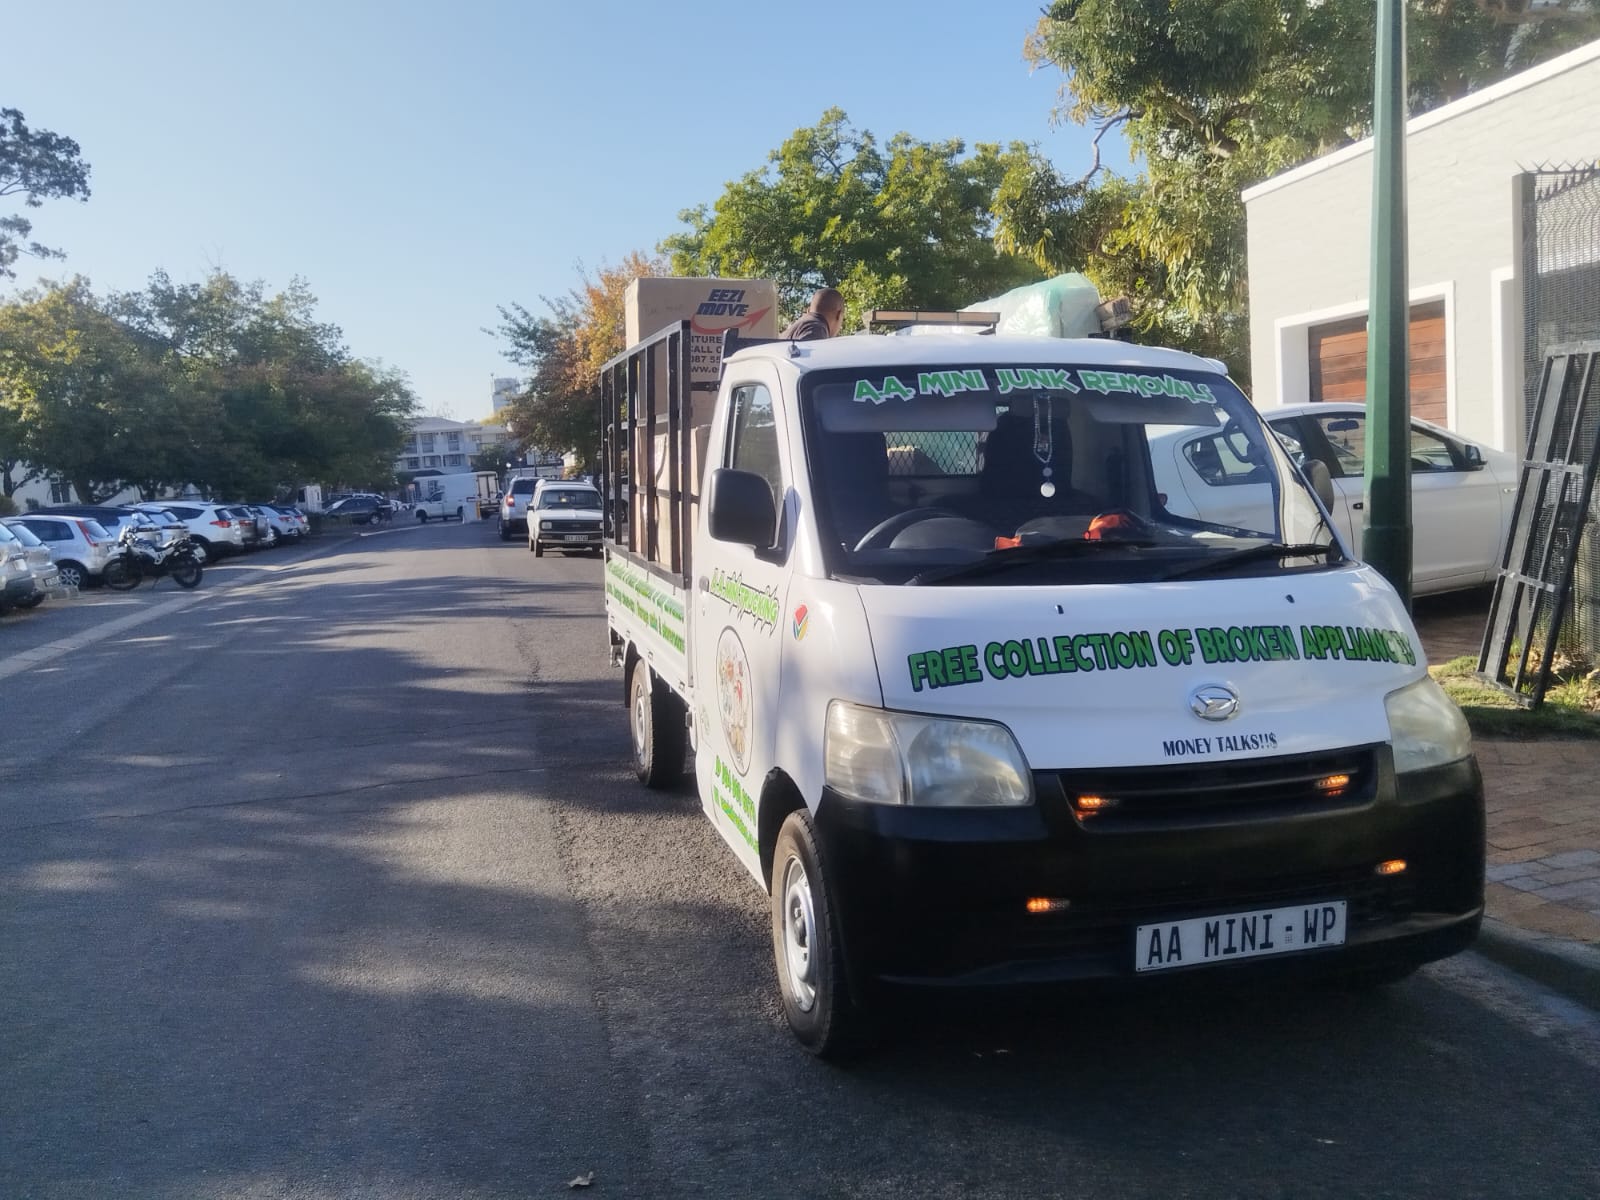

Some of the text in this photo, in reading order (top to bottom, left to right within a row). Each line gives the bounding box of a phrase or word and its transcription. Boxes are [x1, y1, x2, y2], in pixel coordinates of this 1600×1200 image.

[707, 288, 746, 302] EEZI
[695, 302, 749, 317] MOVE
[691, 335, 723, 343] ITURE
[853, 368, 1217, 405] A.A. MINI JUNK REMOVALS
[907, 645, 984, 692] FREE
[984, 631, 1158, 680] COLLECTION
[1158, 628, 1195, 667] OF
[1195, 625, 1301, 664] BROKEN
[1162, 737, 1211, 757] MONEY
[1147, 925, 1182, 965] AA
